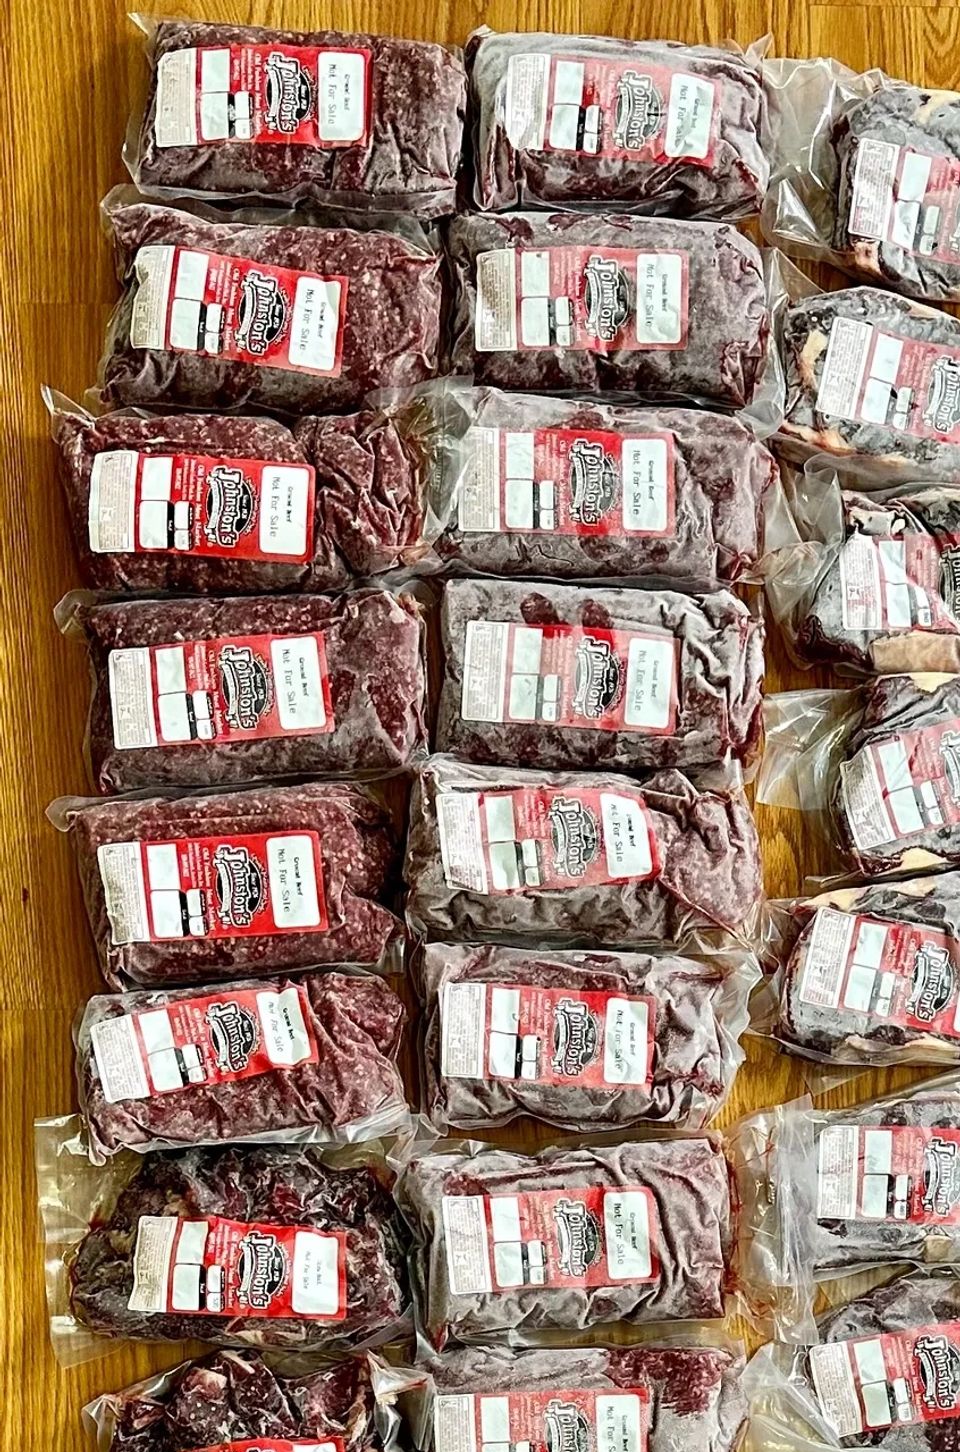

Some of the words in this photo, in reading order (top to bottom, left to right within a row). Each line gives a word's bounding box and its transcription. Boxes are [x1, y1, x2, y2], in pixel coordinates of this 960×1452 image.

[328, 64, 336, 77] Not
[277, 59, 296, 130] Johnston's
[327, 104, 335, 123] Sale
[622, 76, 647, 150] Johnston's
[646, 264, 654, 277] Not
[305, 289, 314, 304] Not
[594, 261, 613, 337] Johnston's
[645, 284, 653, 298] For
[247, 278, 277, 353] Johnston's
[302, 308, 311, 323] For
[299, 329, 309, 350] Sale
[633, 450, 641, 464] Not
[271, 477, 279, 490] Not
[578, 446, 600, 522] Johnston's
[633, 471, 641, 484] For
[216, 471, 238, 544] Johnston's
[632, 492, 640, 514] Sale
[270, 515, 278, 536] Sale
[282, 648, 290, 664] Not
[638, 650, 646, 663] Not
[284, 670, 293, 685] For
[584, 642, 605, 716] Johnston's
[636, 669, 644, 684] For
[233, 652, 256, 728] Johnston's
[634, 689, 643, 710] Sale
[287, 691, 296, 713] Sale
[556, 804, 589, 876] Johnston's
[277, 848, 286, 863] Not
[279, 869, 287, 883] For
[225, 851, 250, 924] Johnston's
[281, 890, 290, 912] Sale
[917, 947, 948, 1022] Johnston's
[216, 1006, 245, 1072] Johnston's
[560, 1003, 586, 1075] Johnston's
[932, 1143, 953, 1215] Johnston's
[564, 1204, 584, 1275] Johnston's
[615, 1224, 623, 1238] For
[247, 1236, 273, 1305] Johnston's
[925, 1338, 951, 1409] Johnston's
